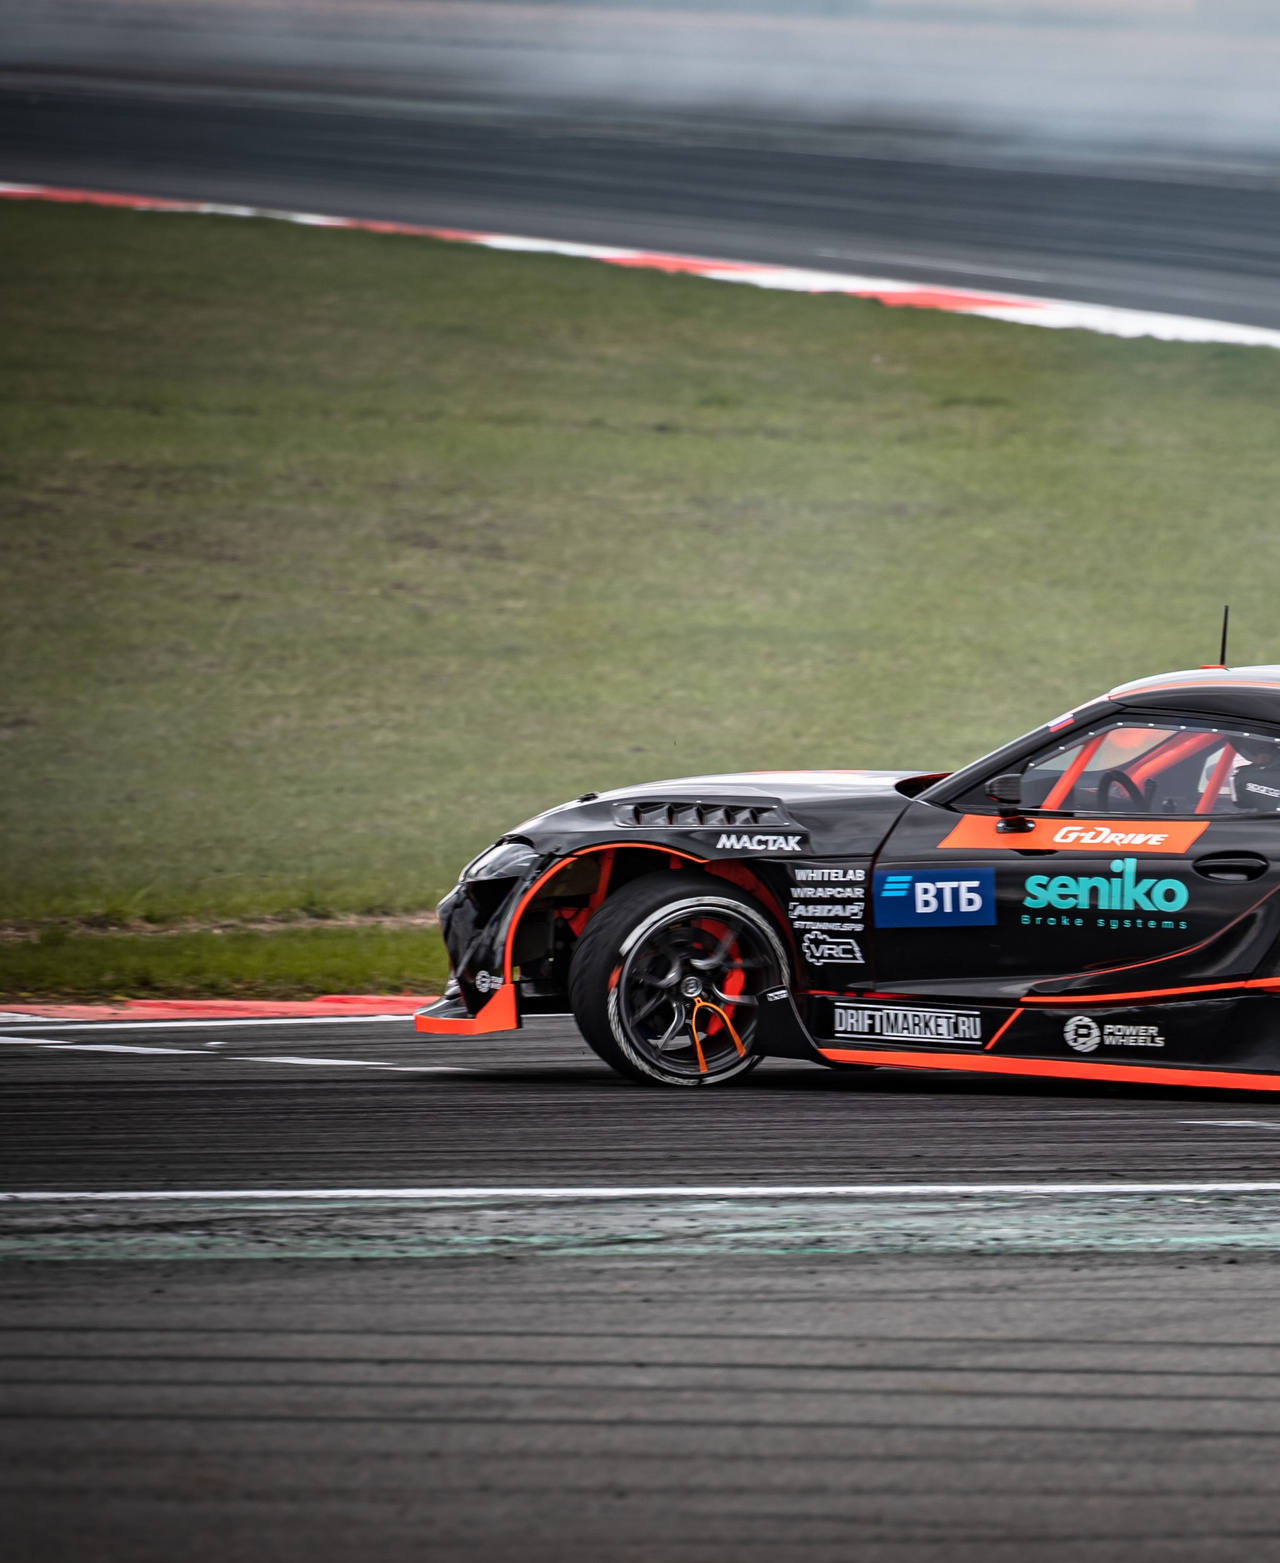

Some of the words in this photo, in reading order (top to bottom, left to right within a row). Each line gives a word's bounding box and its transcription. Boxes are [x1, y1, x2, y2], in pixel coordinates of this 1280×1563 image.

[795, 869, 865, 881] WHITELAB
[790, 887, 865, 898] WRAPCAR
[1023, 858, 1189, 913] seniko
[915, 881, 983, 913] ВТБ
[1021, 915, 1084, 926] Brake
[1097, 918, 1188, 930] systems
[809, 944, 854, 958] VRC
[834, 1008, 981, 1039] DRIFTMARKET.RU
[1103, 1025, 1159, 1036] POWER
[1103, 1035, 1165, 1047] WHEELS
